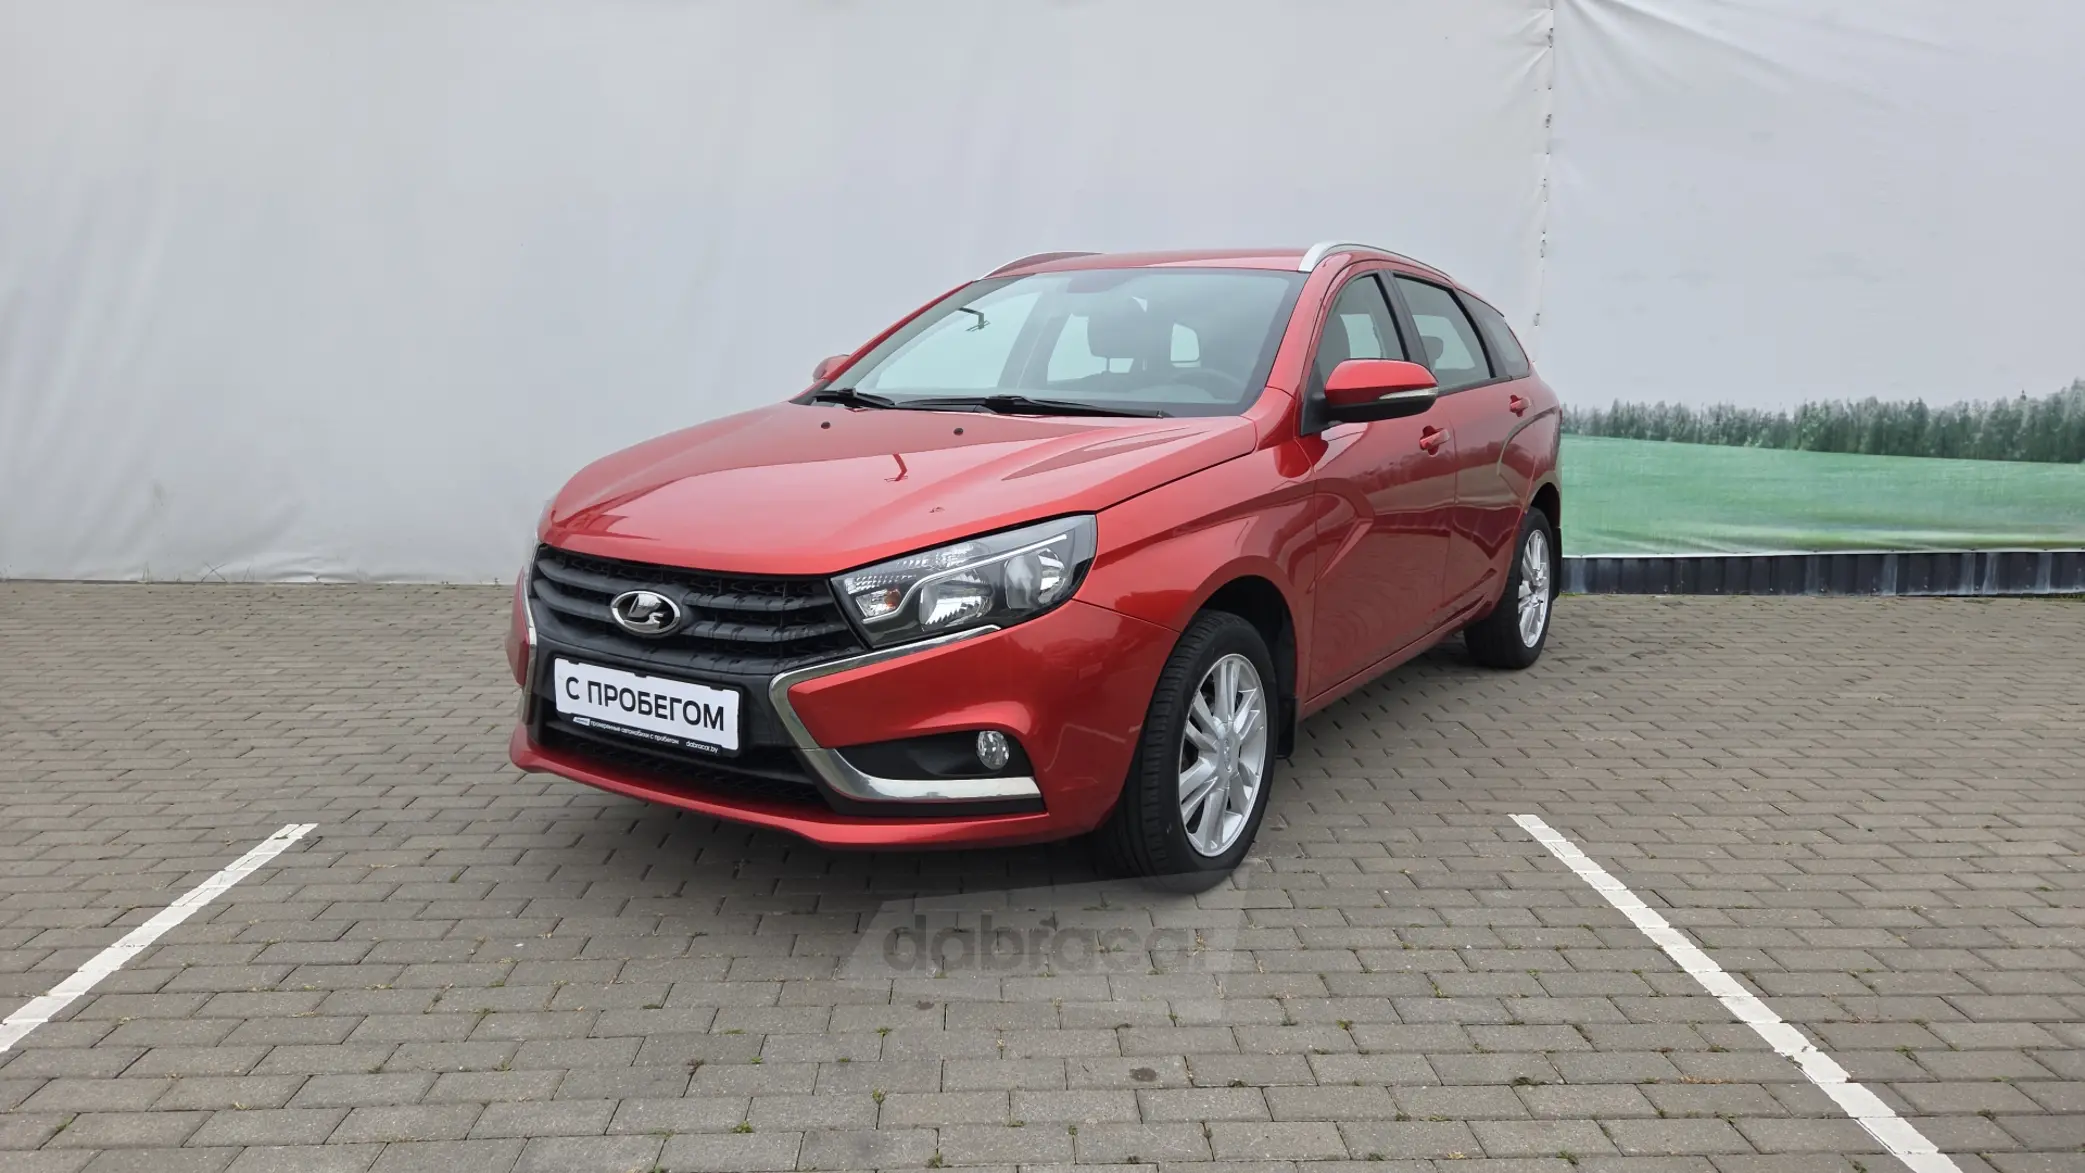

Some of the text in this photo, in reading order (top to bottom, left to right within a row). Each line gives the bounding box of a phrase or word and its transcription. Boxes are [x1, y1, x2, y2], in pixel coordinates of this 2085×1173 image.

[565, 676, 724, 732] С ПРОБЕГОМ
[654, 734, 680, 746] пробегом
